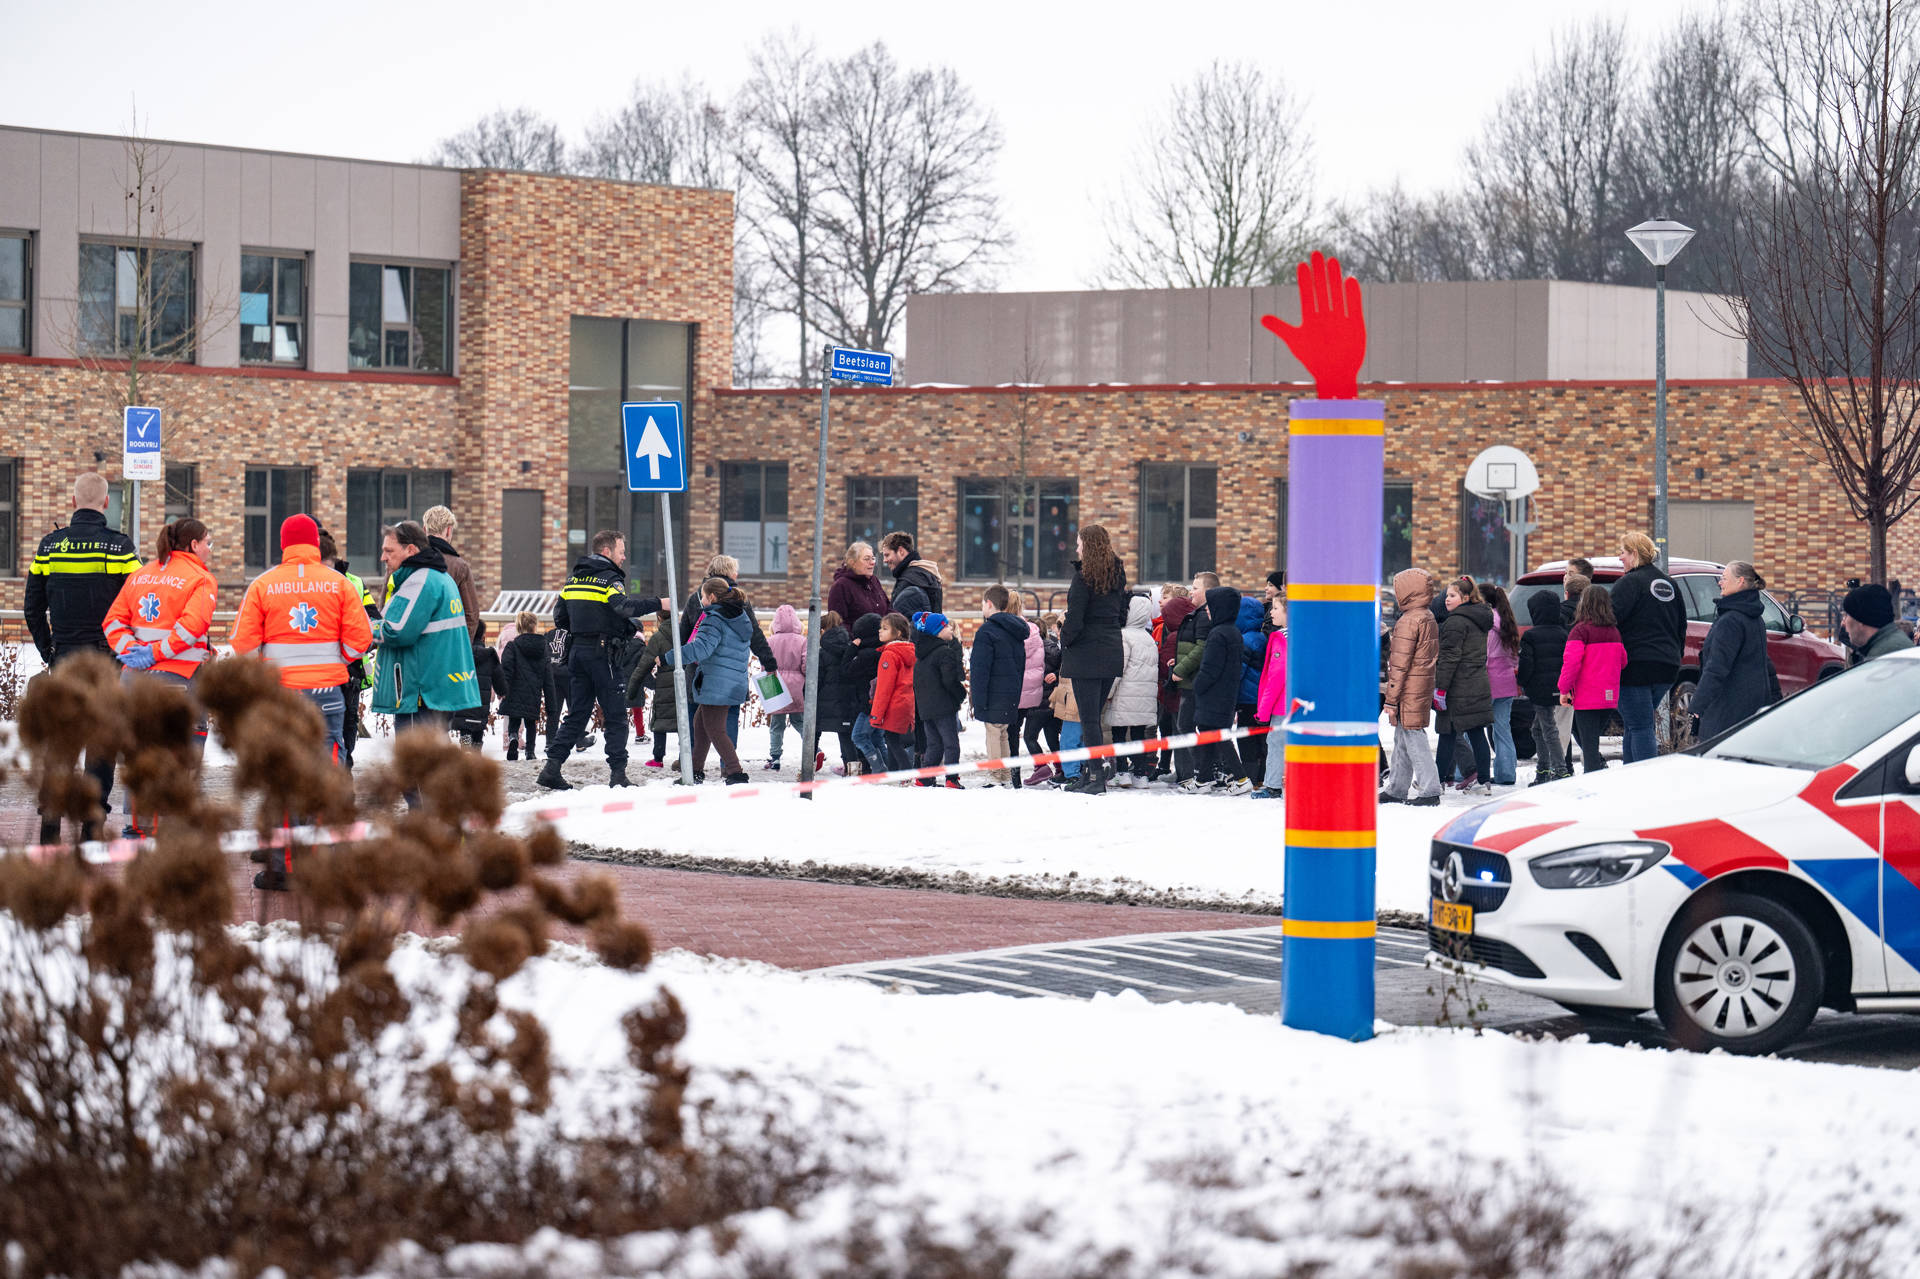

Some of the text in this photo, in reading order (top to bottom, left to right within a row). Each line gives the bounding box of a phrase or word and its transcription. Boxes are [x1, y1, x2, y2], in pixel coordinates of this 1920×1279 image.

[839, 354, 886, 371] Beetslaan
[129, 440, 159, 449] ROOKVRIJ
[55, 537, 101, 552] POLITIE
[130, 575, 187, 590] AMBULANCE
[266, 581, 340, 595] AMBULANCE
